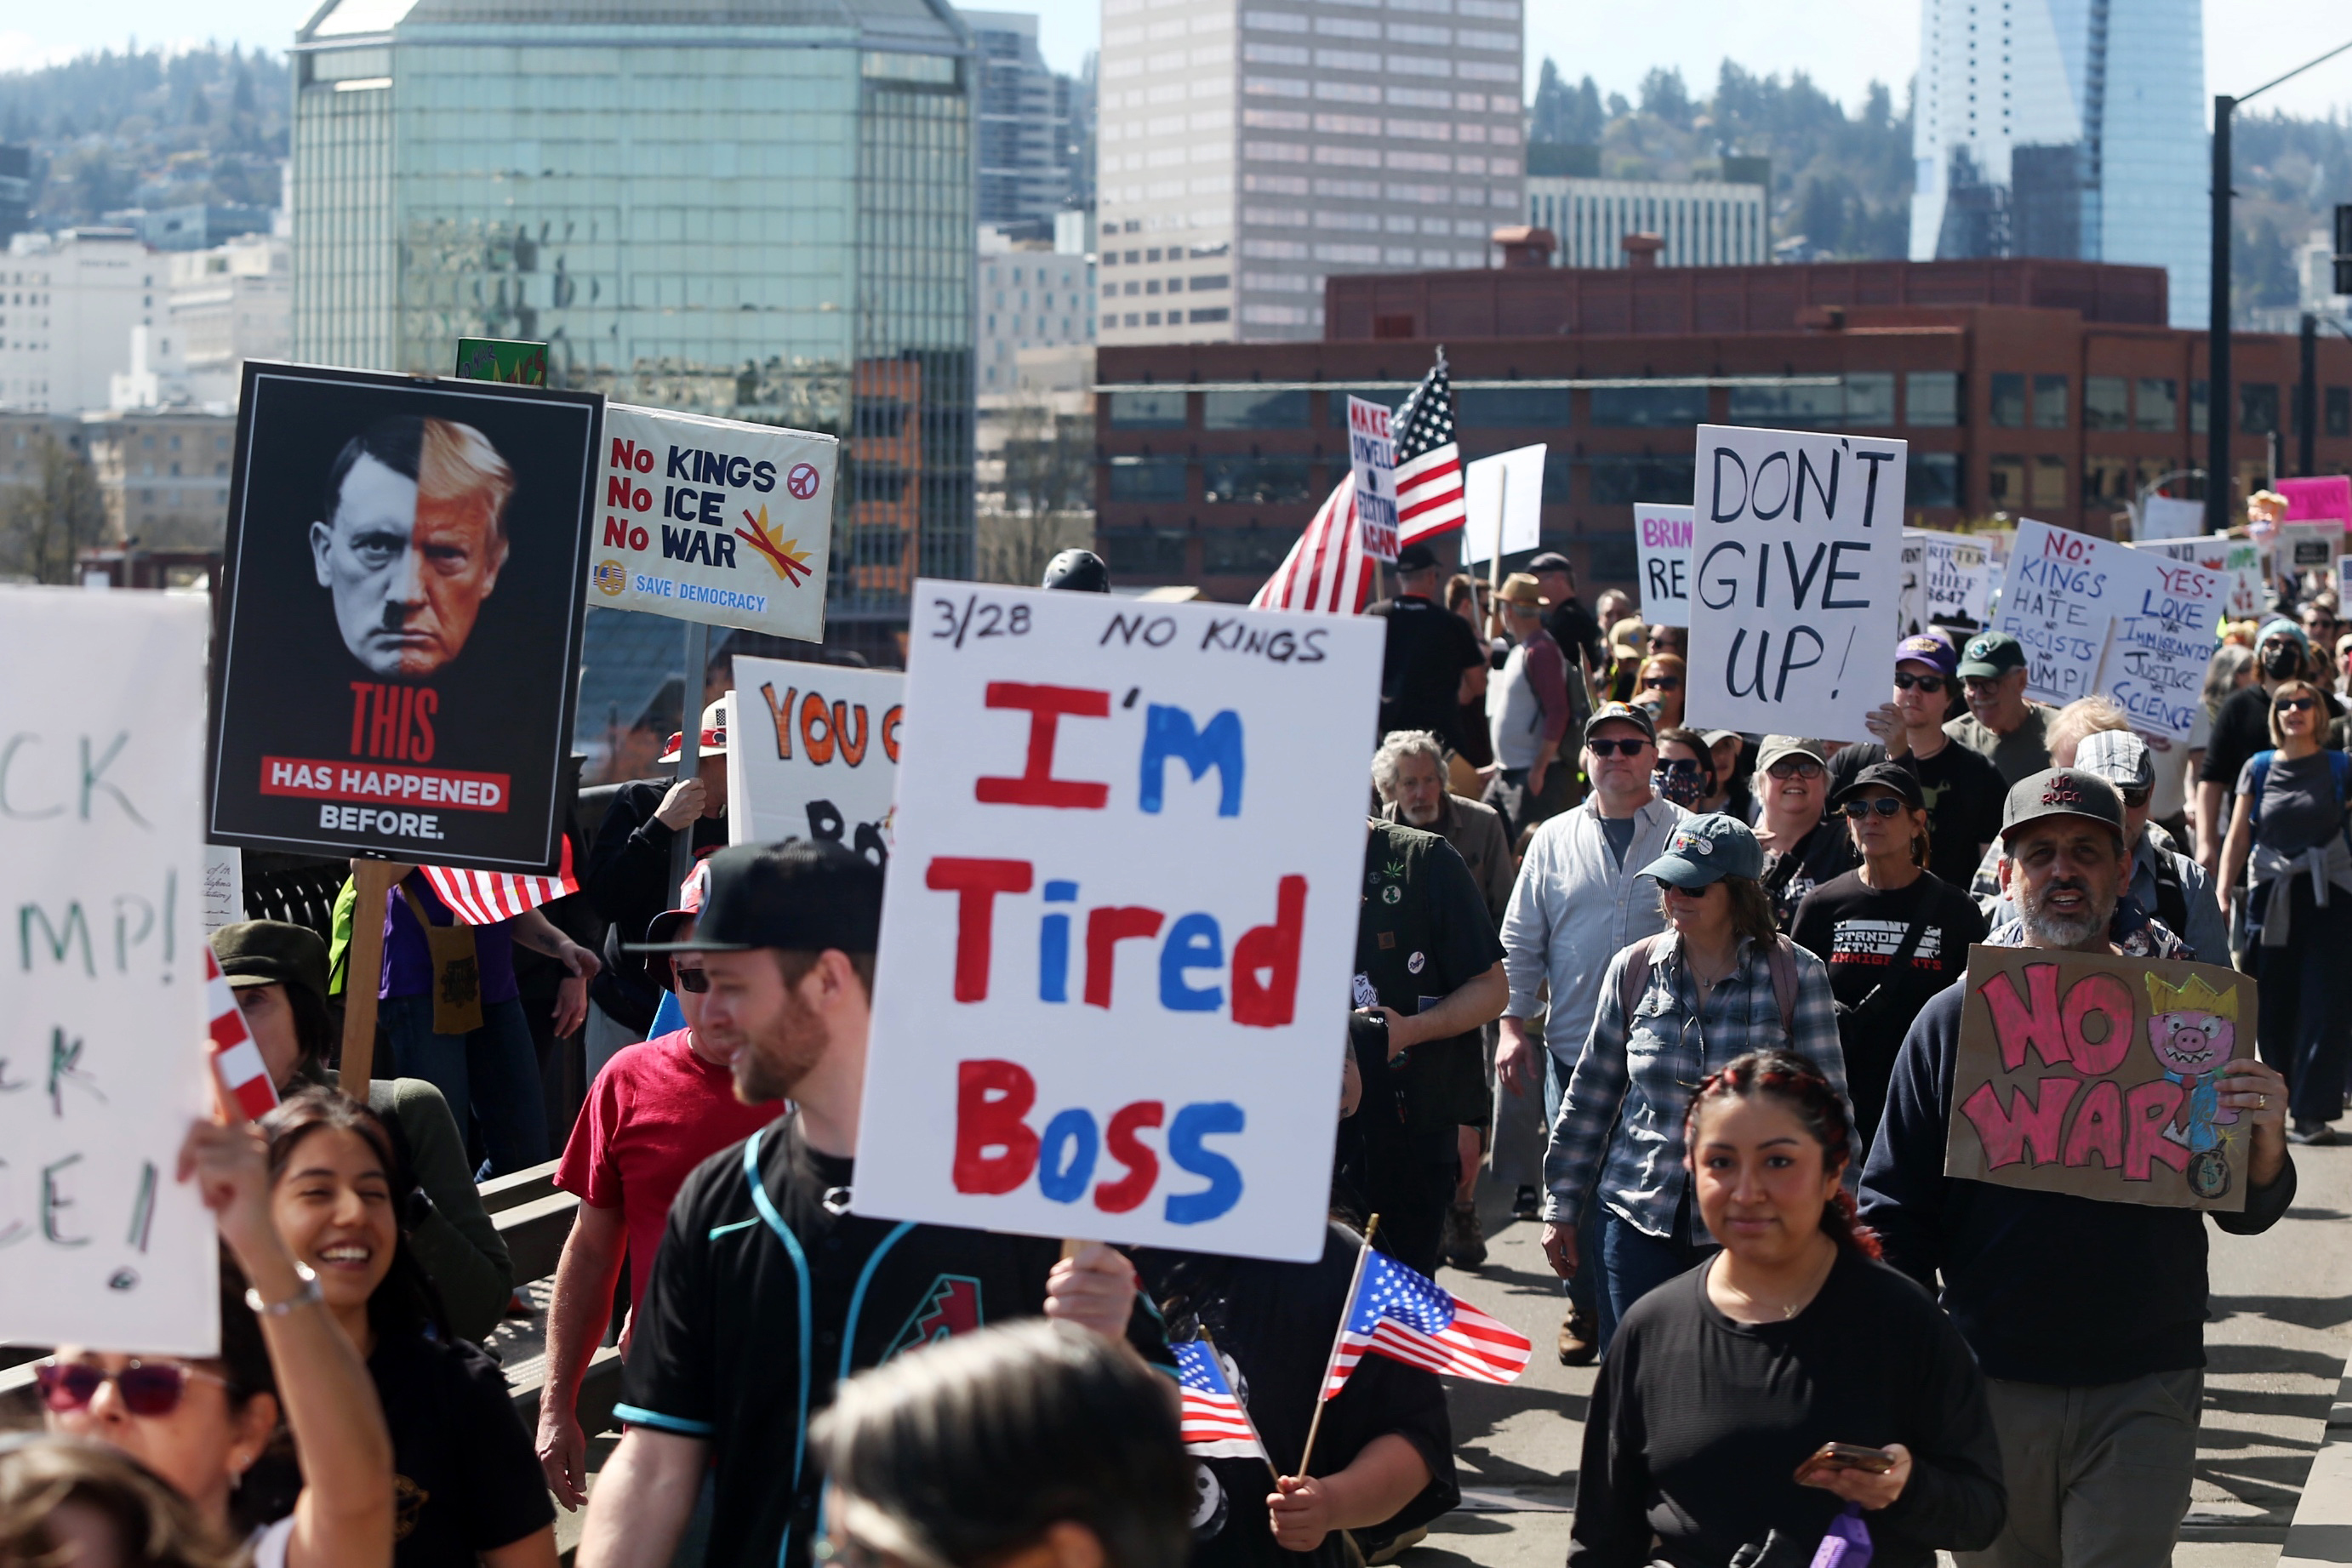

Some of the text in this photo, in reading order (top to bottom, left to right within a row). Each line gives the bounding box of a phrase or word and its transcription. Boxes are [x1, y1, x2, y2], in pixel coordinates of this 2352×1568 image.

[1352, 402, 1390, 438] MAKE
[666, 444, 777, 493] KINGS
[1710, 437, 1895, 527] DON'T
[664, 485, 726, 527] ICE
[661, 524, 737, 569] WAR
[637, 575, 766, 613] SAVE DEMOCRACY
[1647, 557, 1688, 601] RE
[1698, 540, 1871, 611] GIVE
[2019, 555, 2108, 599] KINGS
[2156, 566, 2215, 599] YES:
[932, 594, 1329, 665] 3/28 NO KINGS
[2012, 587, 2088, 627] HATE
[2141, 589, 2205, 629] LOVE
[1726, 624, 1856, 704] UP!
[350, 681, 439, 763] THIS
[760, 681, 869, 769] YOU
[271, 761, 500, 807] HAS HAPPENED
[319, 804, 445, 841] BEFORE.
[925, 855, 1309, 1029] Tired
[1834, 932, 1889, 943] STAND
[1978, 962, 2134, 1075] NO
[1959, 1076, 2191, 1182] WAR
